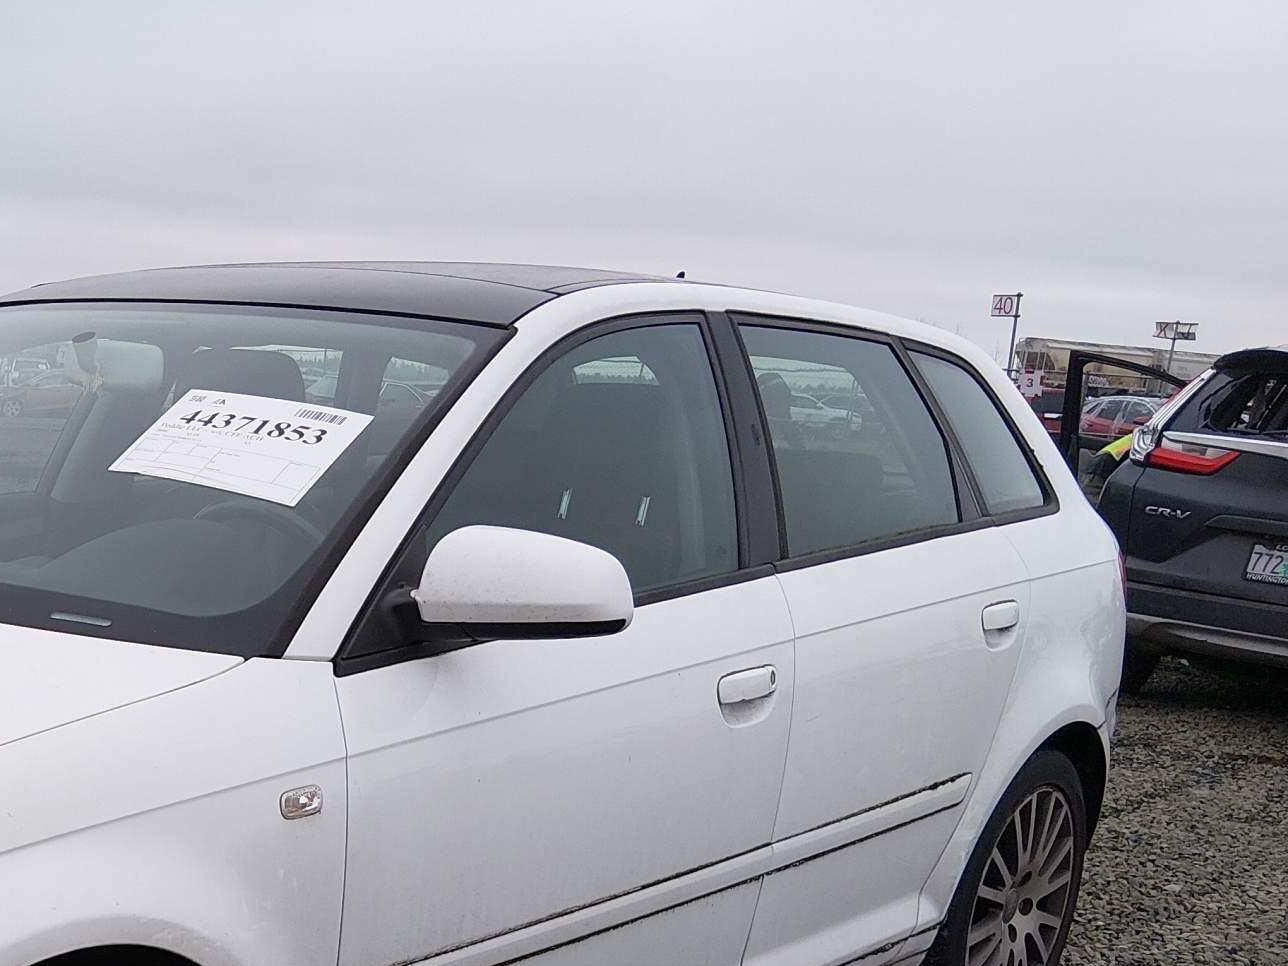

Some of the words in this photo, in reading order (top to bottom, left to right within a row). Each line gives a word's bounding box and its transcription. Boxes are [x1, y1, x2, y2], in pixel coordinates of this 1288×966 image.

[994, 296, 1013, 314] 40
[1026, 378, 1034, 388] 3
[180, 409, 328, 445] 44371853
[1145, 505, 1192, 519] CR-V
[1252, 551, 1285, 575] 772
